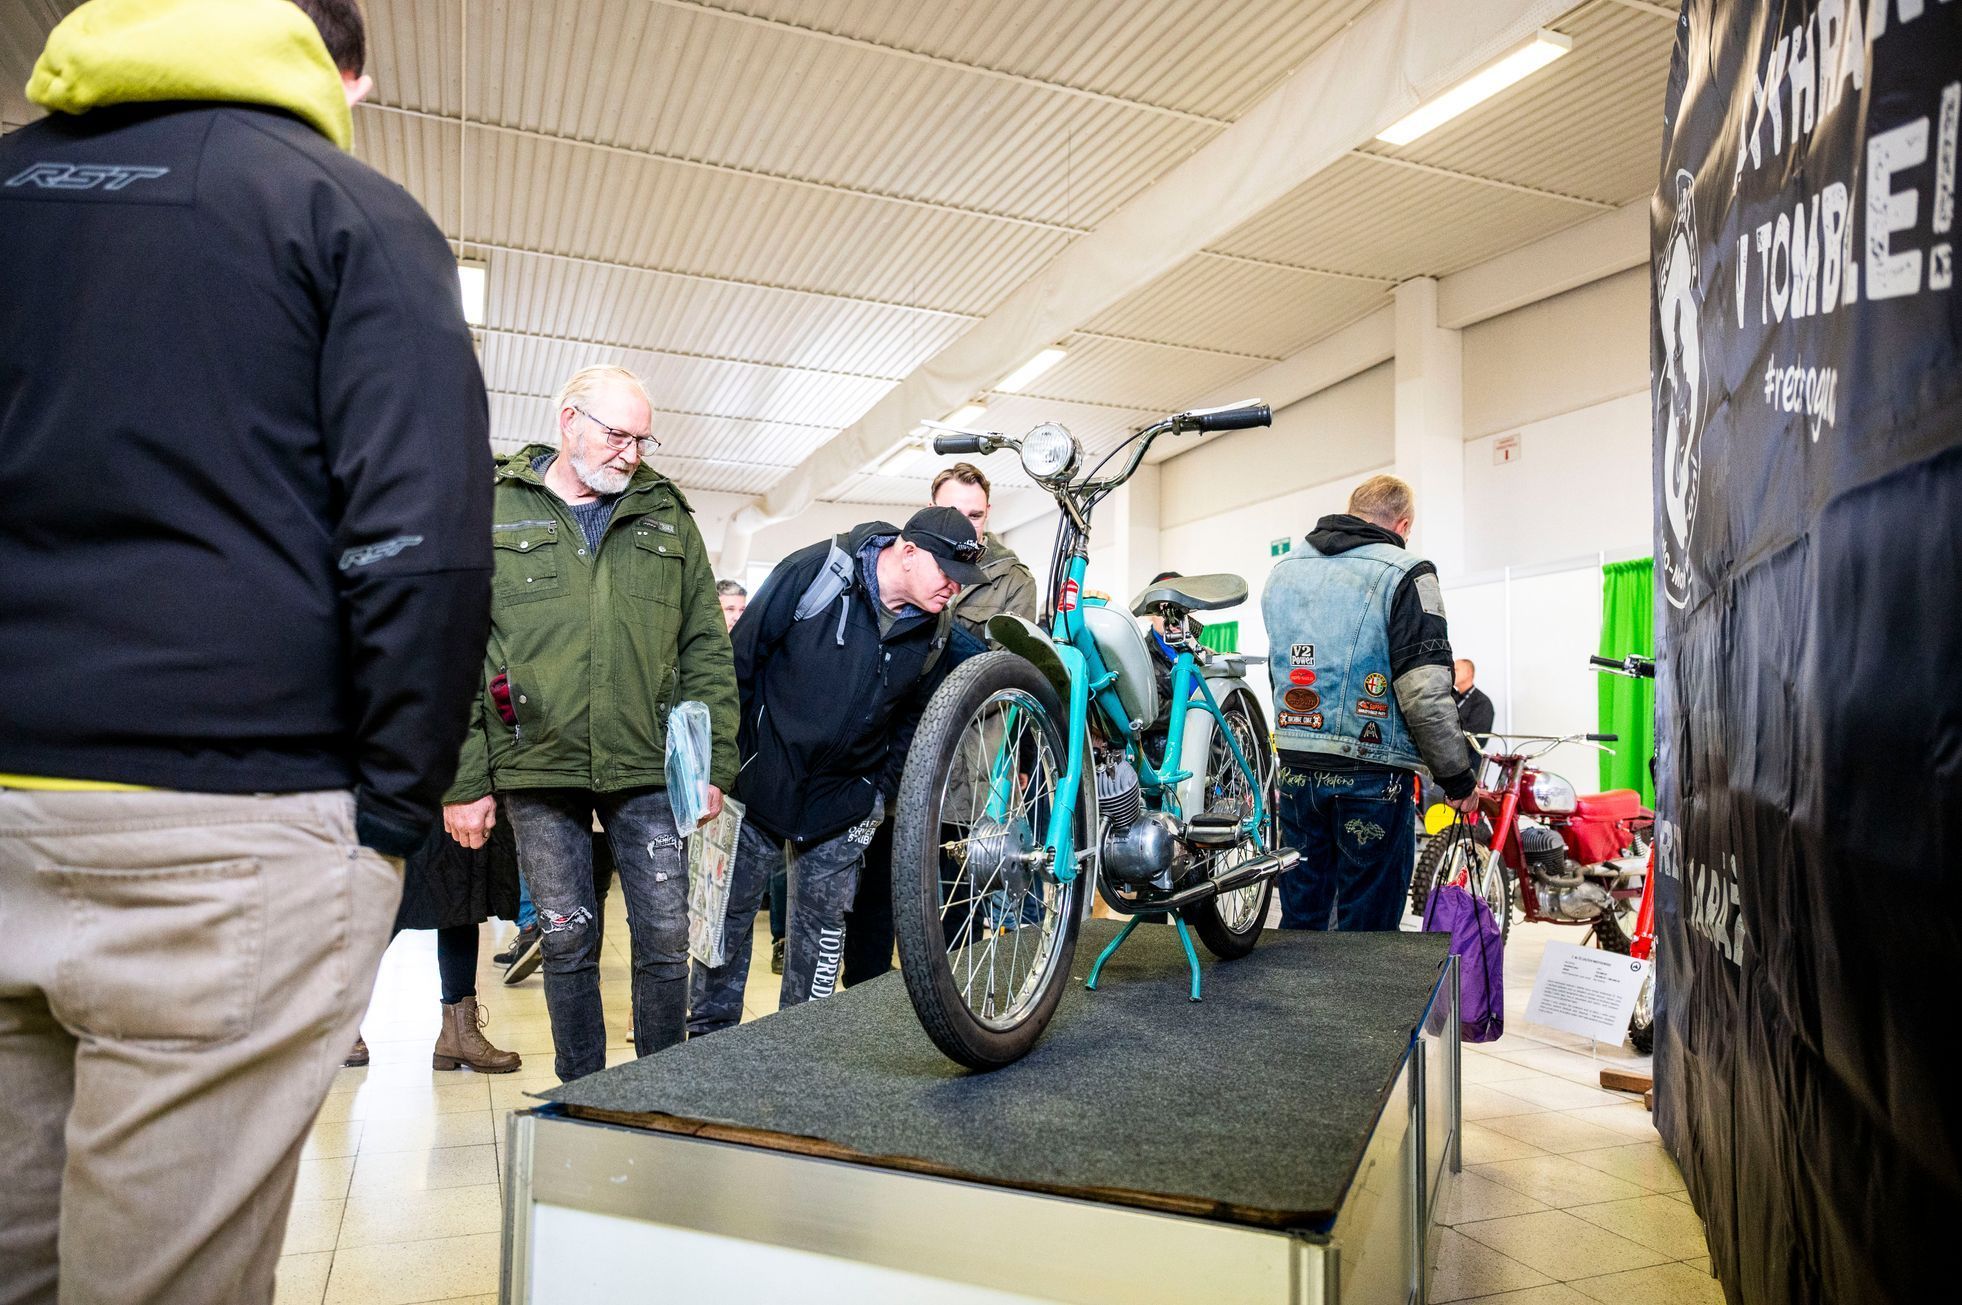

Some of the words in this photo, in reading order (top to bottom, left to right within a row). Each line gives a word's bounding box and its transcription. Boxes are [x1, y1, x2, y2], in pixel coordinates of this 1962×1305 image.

[5, 163, 170, 191] RST
[338, 535, 424, 571] RST
[1292, 656, 1314, 666] Power
[1293, 645, 1312, 657] V2
[808, 927, 843, 1002] TOPRED
